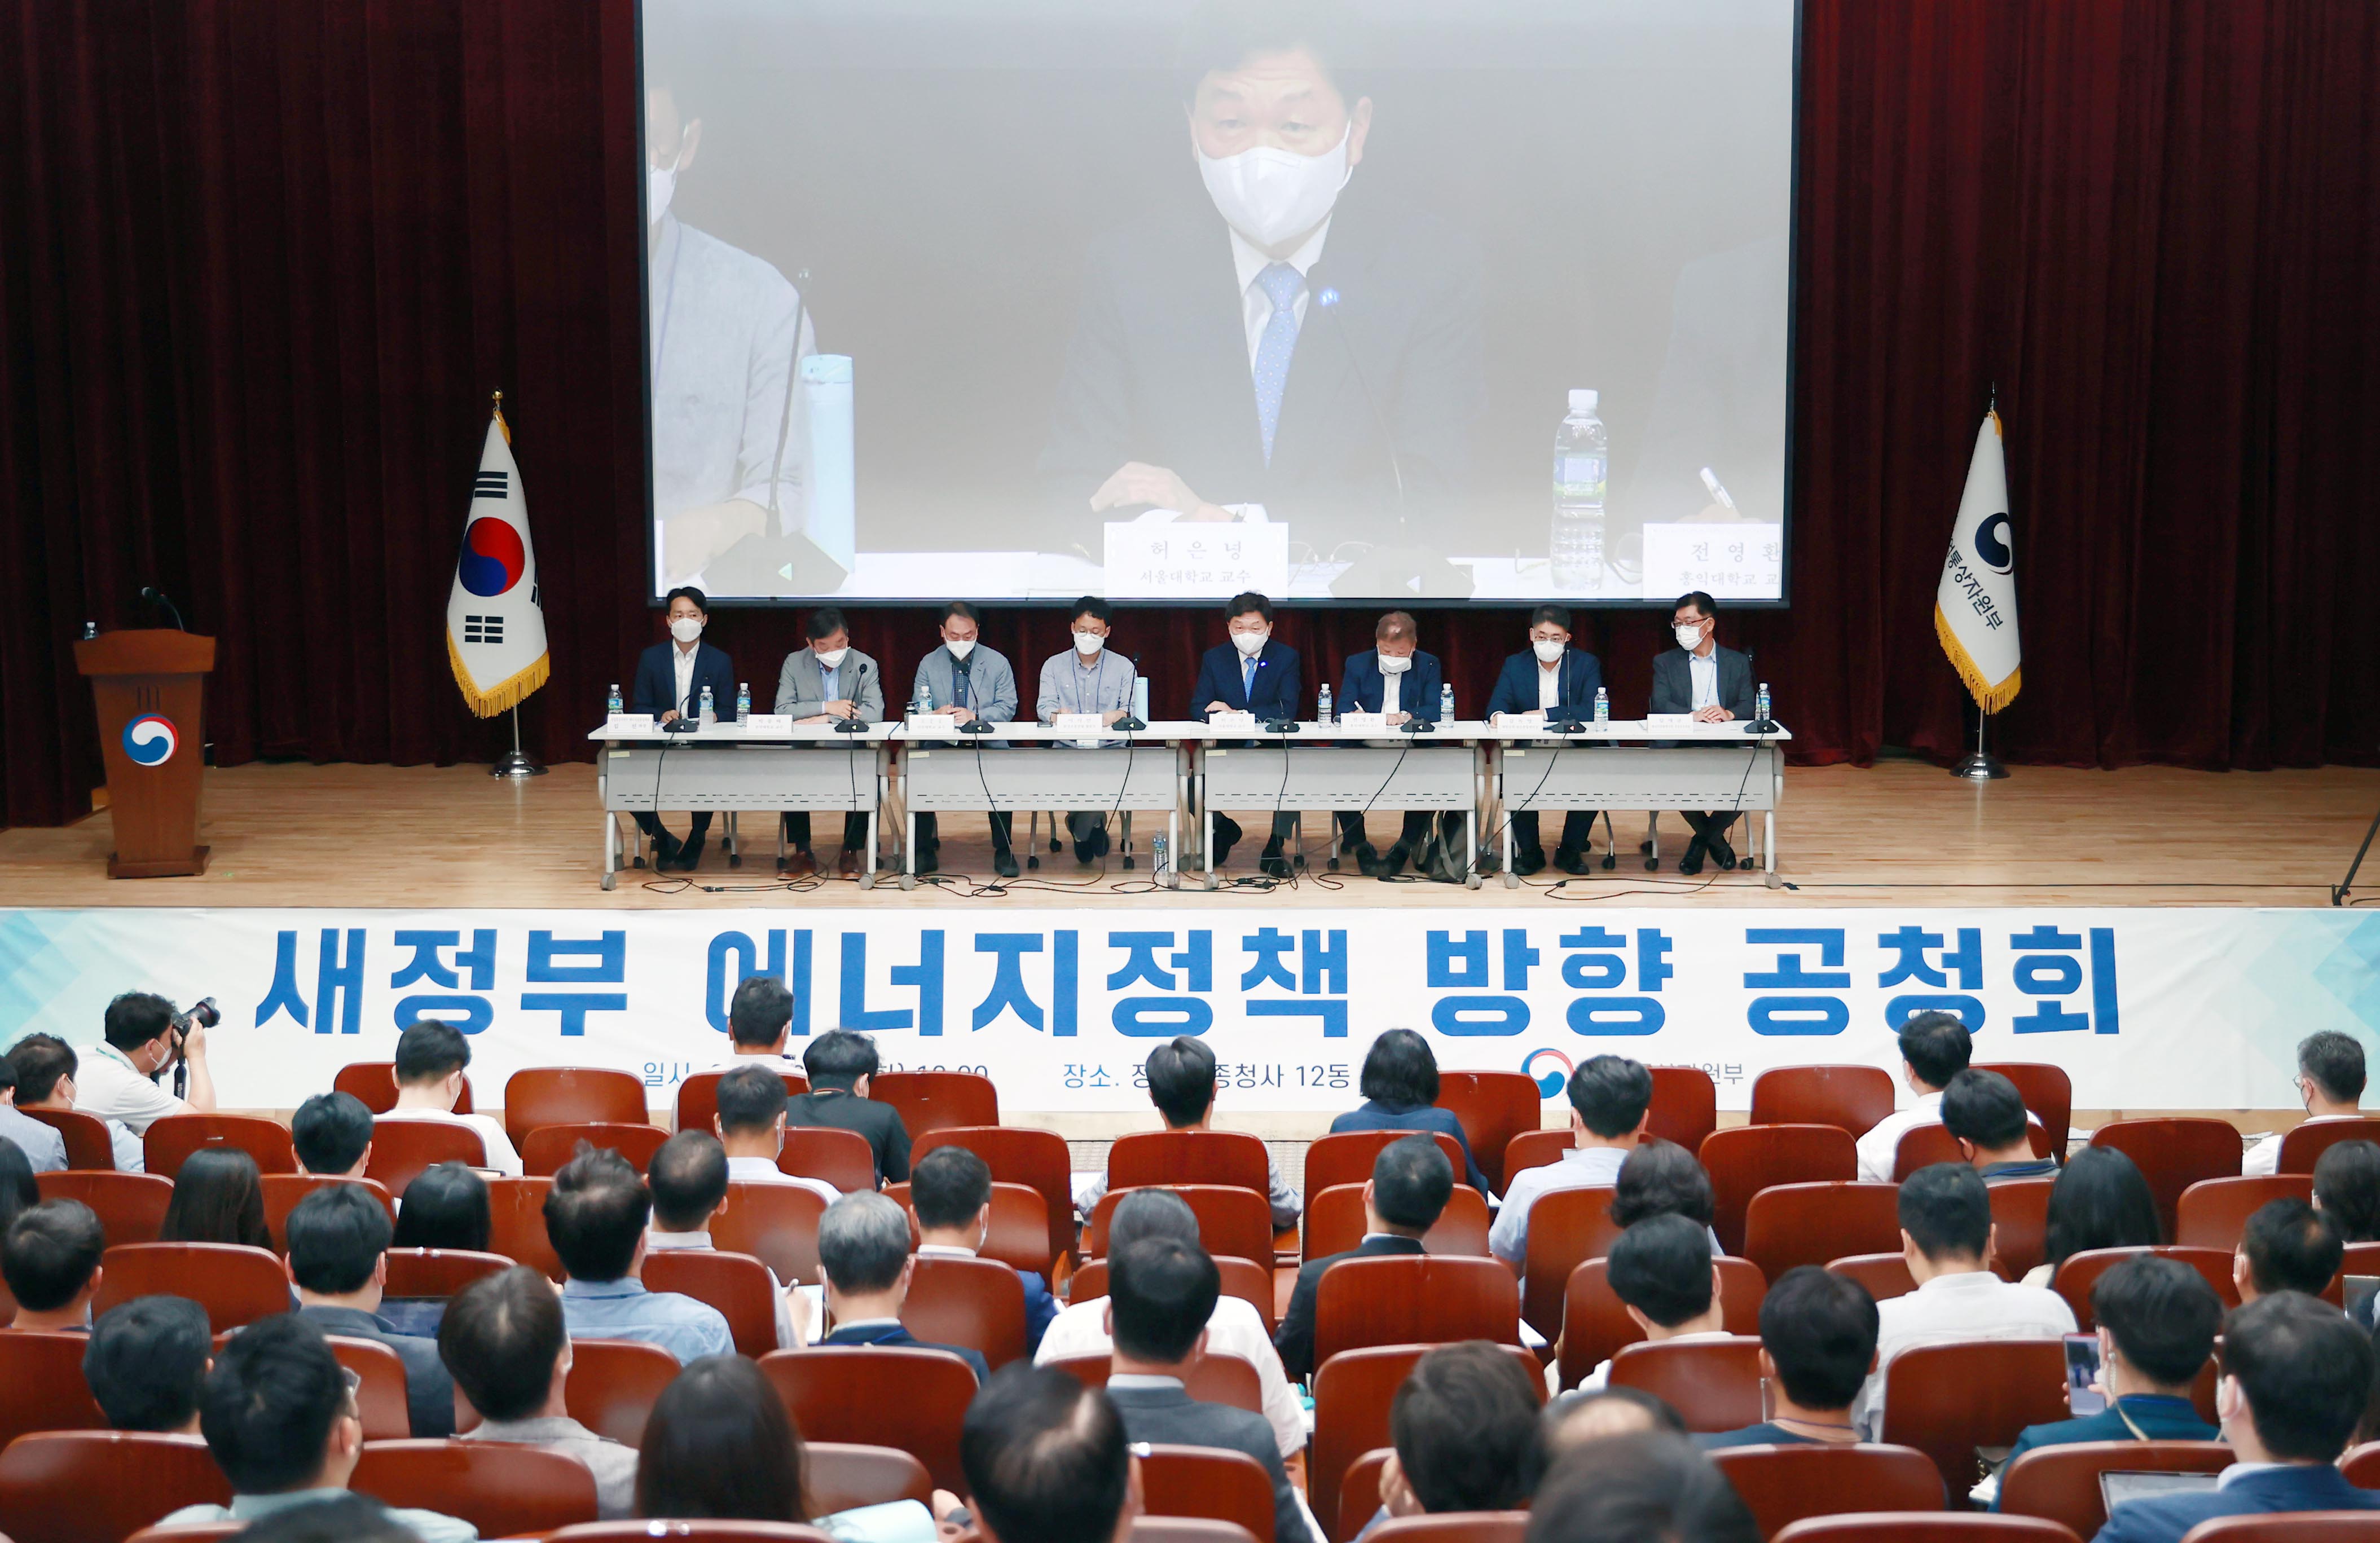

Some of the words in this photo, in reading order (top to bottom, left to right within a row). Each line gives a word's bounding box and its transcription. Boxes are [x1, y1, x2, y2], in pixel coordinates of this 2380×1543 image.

[1140, 570, 1213, 584] 서울대학교
[1219, 570, 1251, 584] 교수
[1679, 571, 1757, 587] 홍익대학교
[255, 928, 627, 1036] 새정부
[705, 927, 1348, 1037] 에너지정책
[1426, 925, 1673, 1036] 방향
[1743, 925, 2119, 1036] 공청회
[1063, 1064, 1119, 1088] 장소.
[1296, 1064, 1350, 1088] 12동
